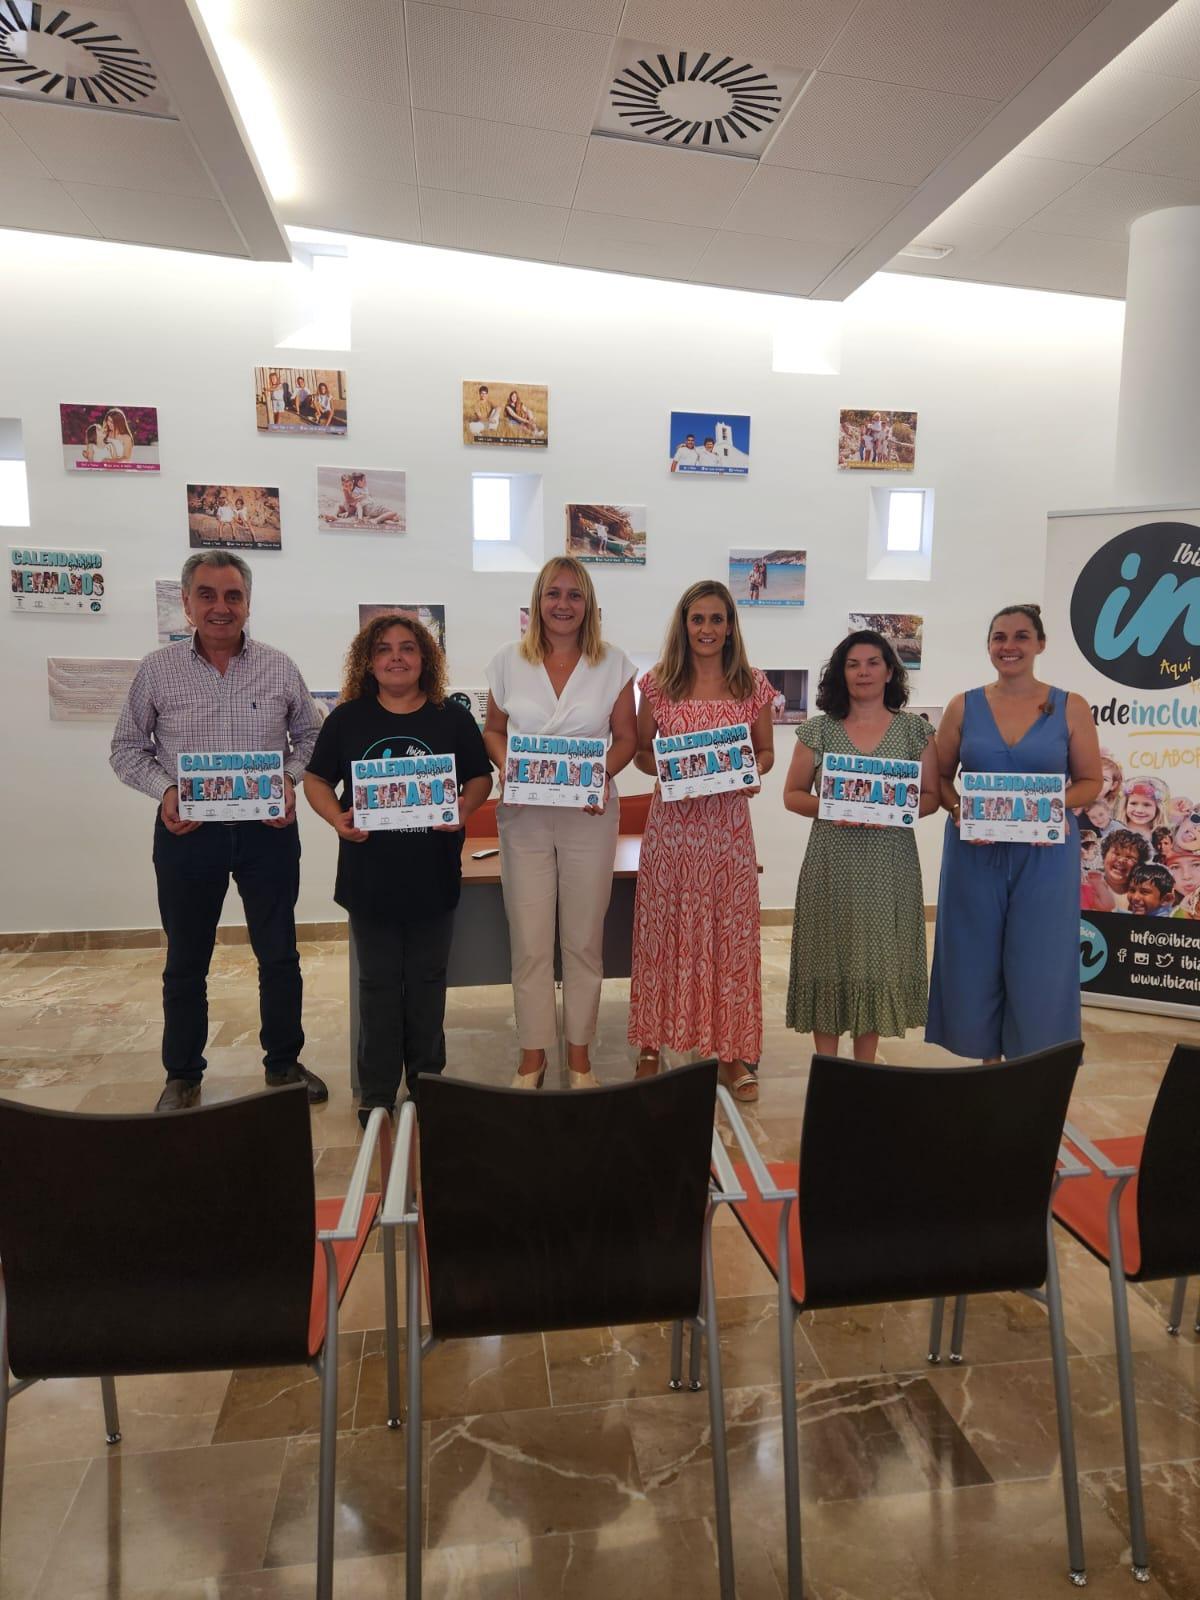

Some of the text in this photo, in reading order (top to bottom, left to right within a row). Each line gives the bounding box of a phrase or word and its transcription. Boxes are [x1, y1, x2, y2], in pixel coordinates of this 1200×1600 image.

[11, 550, 102, 569] CALENDARIO
[11, 570, 104, 596] HERMANOS
[1090, 697, 1200, 728] ndeinclu
[511, 735, 604, 757] CALENDARIO
[656, 725, 748, 754] CALENDARIO
[180, 753, 281, 771] CALENDARIO
[355, 756, 453, 779] CALENDARIO
[507, 757, 604, 788] HERMANOS
[658, 745, 754, 782] HERMANOS
[826, 754, 919, 778] CALENDARIO
[180, 774, 283, 801] HERMANOS
[355, 778, 456, 810] HERMANOS
[822, 775, 918, 808] HERMANOS
[964, 774, 1063, 793] CALENDARIO
[962, 795, 1064, 823] HERMANOS
[1130, 973, 1200, 991] www.ibizai
